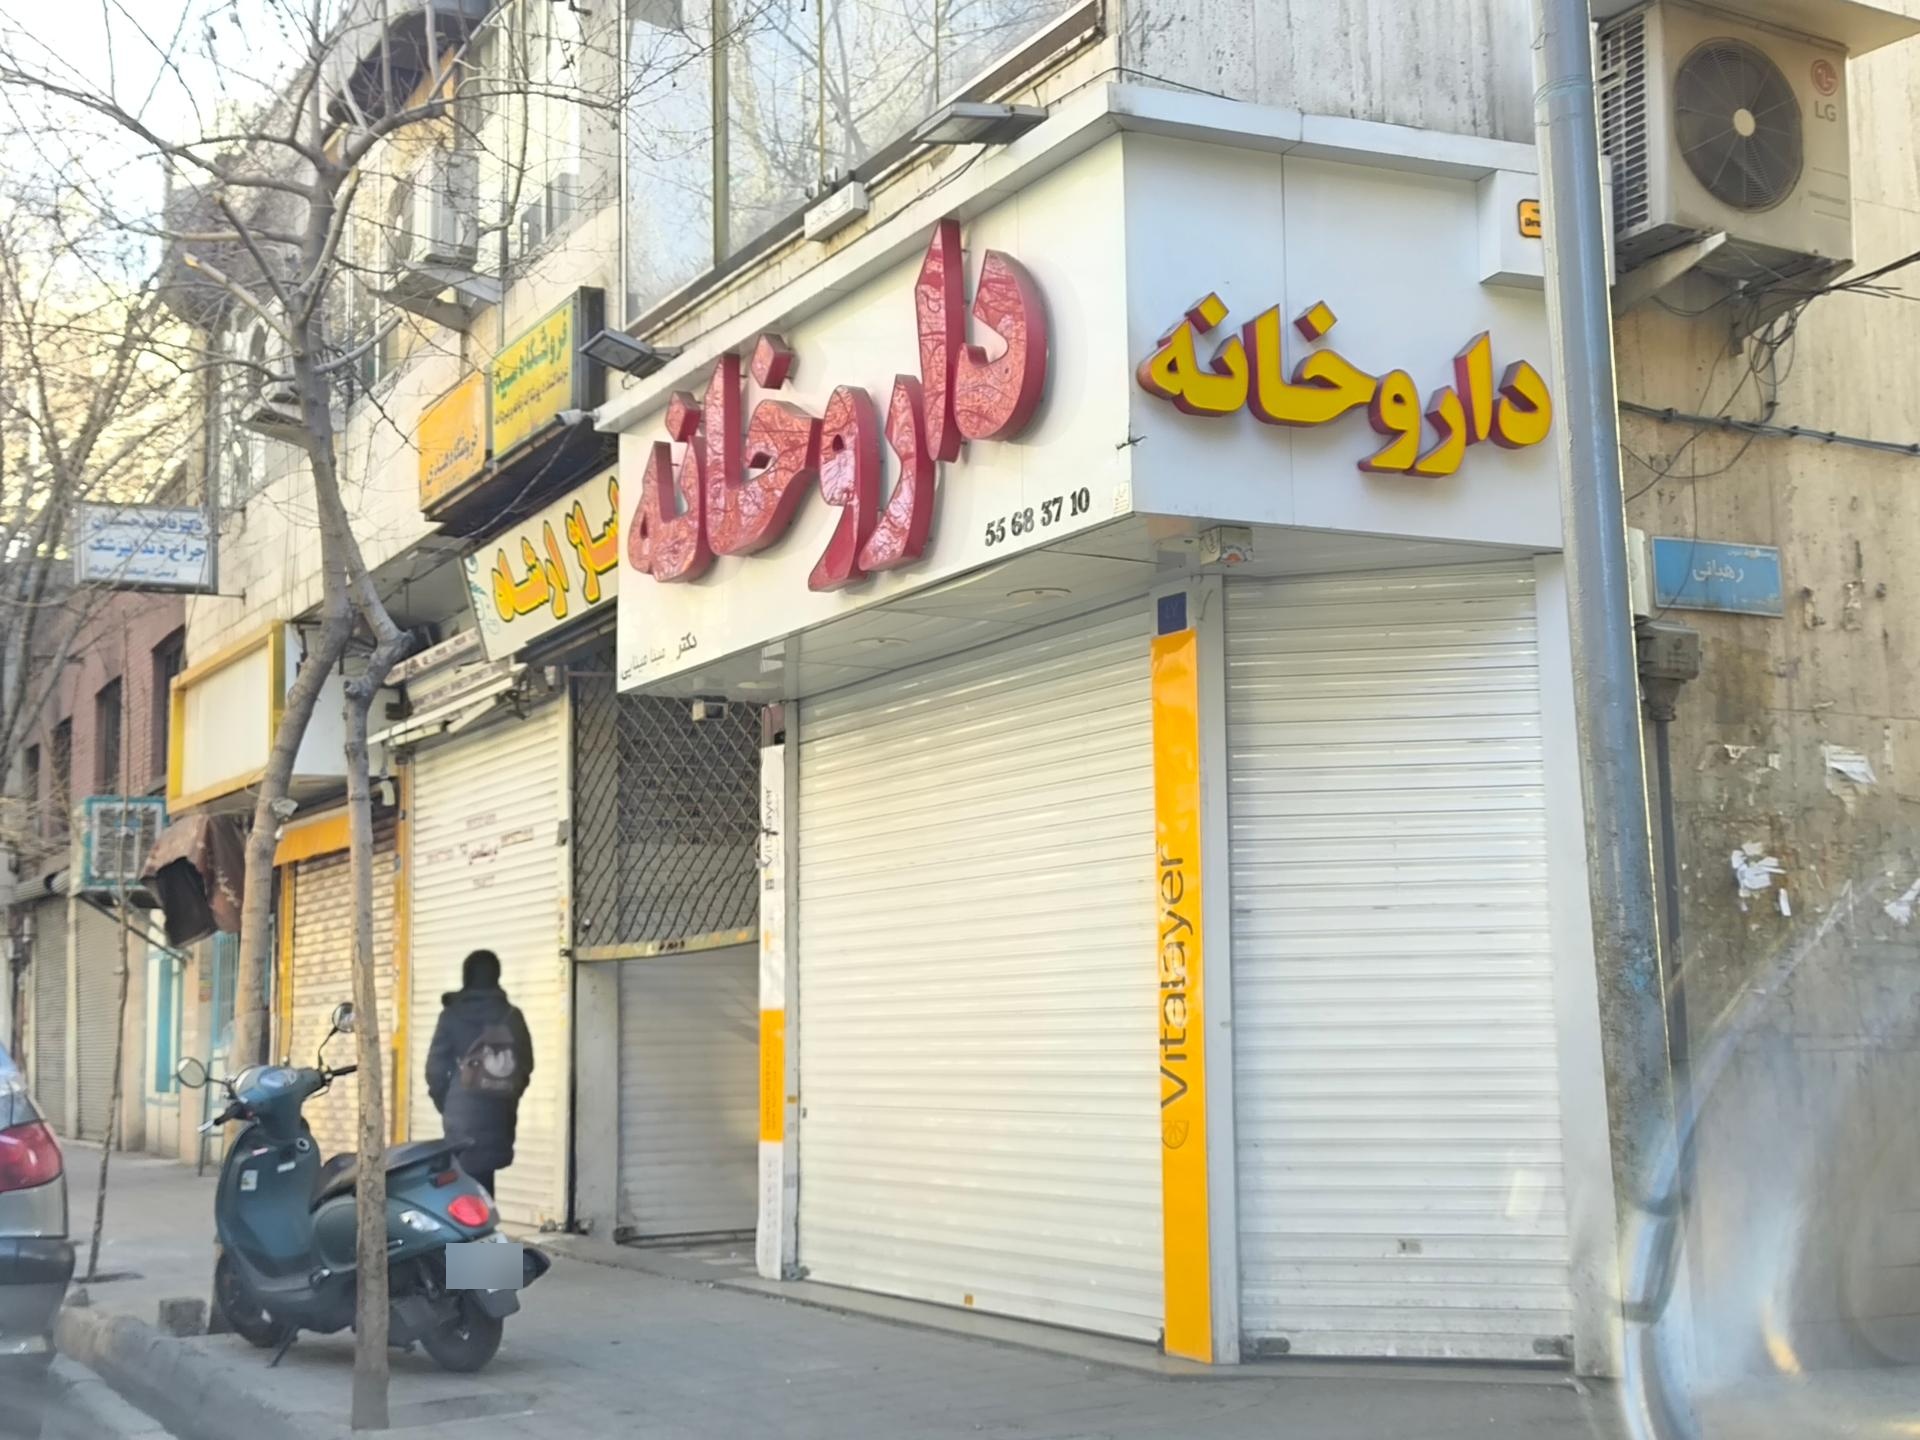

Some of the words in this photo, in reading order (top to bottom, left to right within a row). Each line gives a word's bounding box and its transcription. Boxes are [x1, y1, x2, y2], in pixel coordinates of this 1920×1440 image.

[1814, 100, 1837, 122] LG
[627, 218, 1049, 592] داروخانه
[1137, 291, 1552, 477] داروخانه
[984, 516, 1006, 547] 55
[1011, 507, 1035, 536] 68
[1040, 496, 1064, 527] 37
[1070, 486, 1091, 517] 10
[1159, 844, 1193, 1109] Vitalayer
